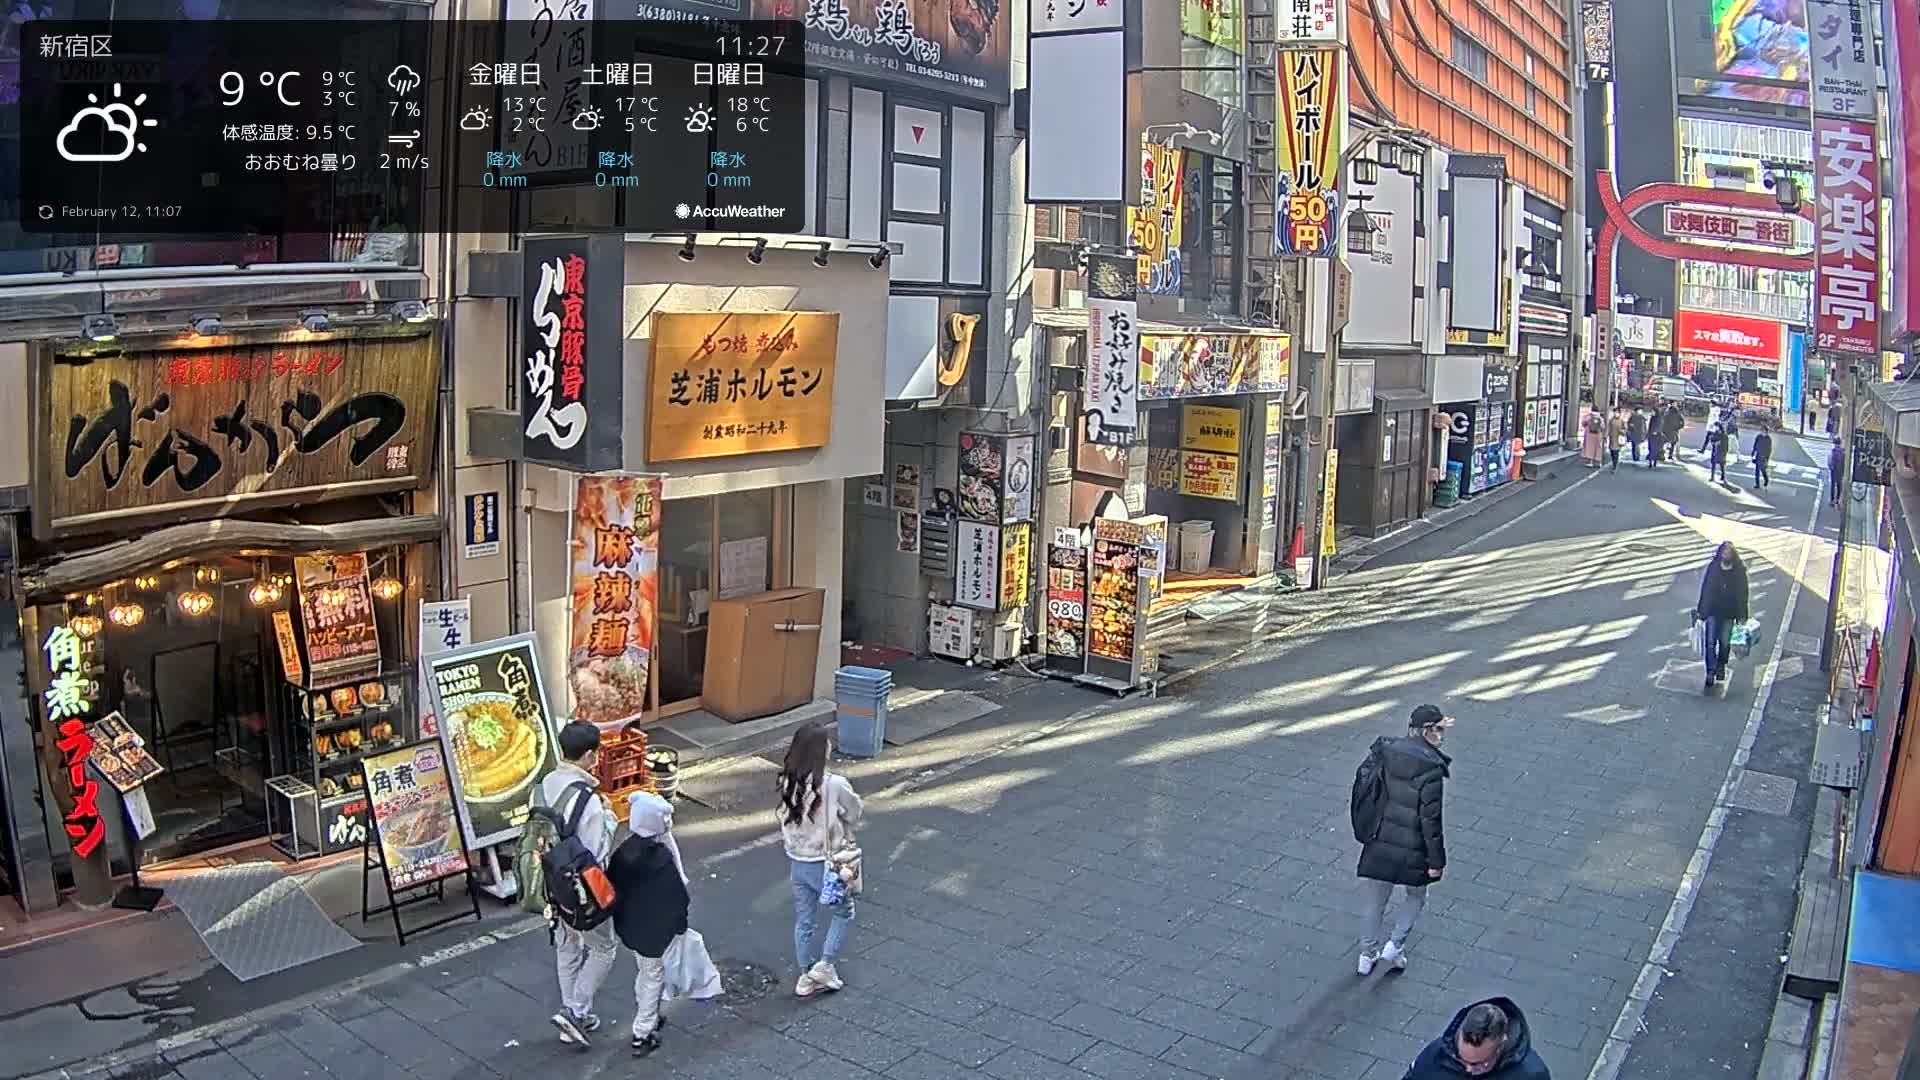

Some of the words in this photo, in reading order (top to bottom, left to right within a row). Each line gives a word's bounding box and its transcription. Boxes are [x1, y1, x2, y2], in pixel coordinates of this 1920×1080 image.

[1589, 64, 1609, 79] 7F
[1833, 98, 1856, 112] 3F
[1295, 54, 1321, 190] ハイボール
[1289, 196, 1326, 222] 50
[1295, 225, 1319, 252] 円
[1670, 211, 1789, 242] 歌舞伎町一番街
[1818, 128, 1874, 330] 安楽亭
[561, 254, 585, 401] 東京豚骨
[1819, 334, 1837, 348] 2F
[1105, 310, 1134, 413] お好み焼き
[668, 367, 823, 406] 芝浦ホルモン
[588, 523, 636, 657] 麻辣麺
[435, 663, 480, 683] TOKYO
[439, 677, 482, 697] RAMEN
[371, 763, 417, 797] 角煮
